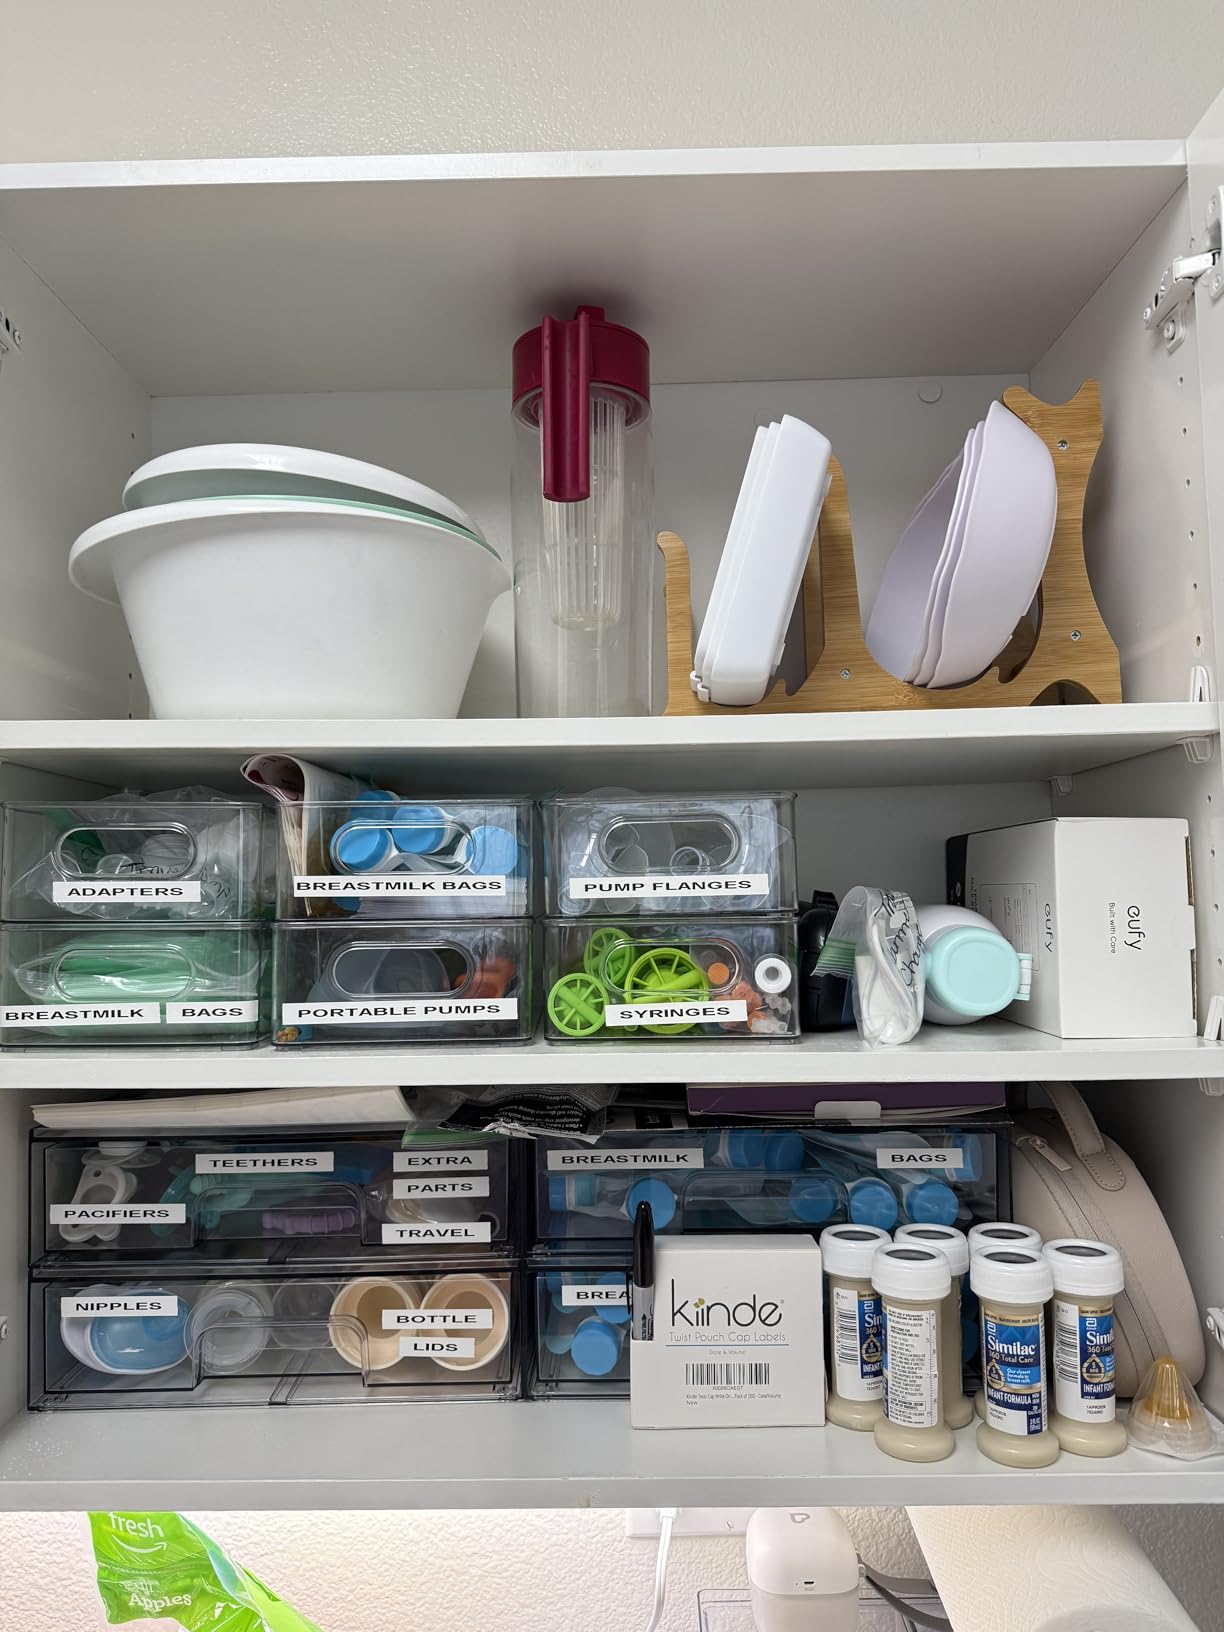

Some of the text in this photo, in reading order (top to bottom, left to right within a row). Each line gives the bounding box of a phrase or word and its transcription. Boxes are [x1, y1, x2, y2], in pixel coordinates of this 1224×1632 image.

[296, 880, 502, 891] BREASTMILK BAGS
[584, 880, 752, 892] PUMP FLANGES
[67, 887, 184, 897] ADAPTERS
[1108, 902, 1116, 918] Built
[1044, 903, 1054, 953] eufy
[1124, 905, 1146, 951] eufy
[5, 1009, 144, 1020] BREASTMILK
[182, 1007, 243, 1017] BAGS
[298, 1005, 501, 1018] PORTABLE PUMPS
[619, 1007, 731, 1019] SYRINGES
[209, 1157, 318, 1168] TEETHERS
[407, 1156, 473, 1166] EXTRA
[561, 1154, 689, 1164] BREASTMILK
[891, 1154, 948, 1163] BAGS
[407, 1183, 473, 1193] PARTS
[64, 1209, 170, 1219] PACIFIERS
[395, 1228, 475, 1238] TRAVEL
[75, 1301, 162, 1312] NIPPLES
[671, 1278, 783, 1327] kiinde
[396, 1315, 477, 1324] BOTTLE
[669, 1331, 786, 1344] Twist Pouch Cap Labels
[413, 1342, 458, 1352] LIDS
[987, 1334, 1036, 1356] Similac
[1000, 1353, 1017, 1363] Total
[1018, 1355, 1034, 1364] Care
[1083, 1383, 1104, 1393] INFANT
[1004, 1392, 1032, 1405] FORMULA
[107, 1511, 165, 1538] fresh
[128, 1592, 192, 1613] Apples
